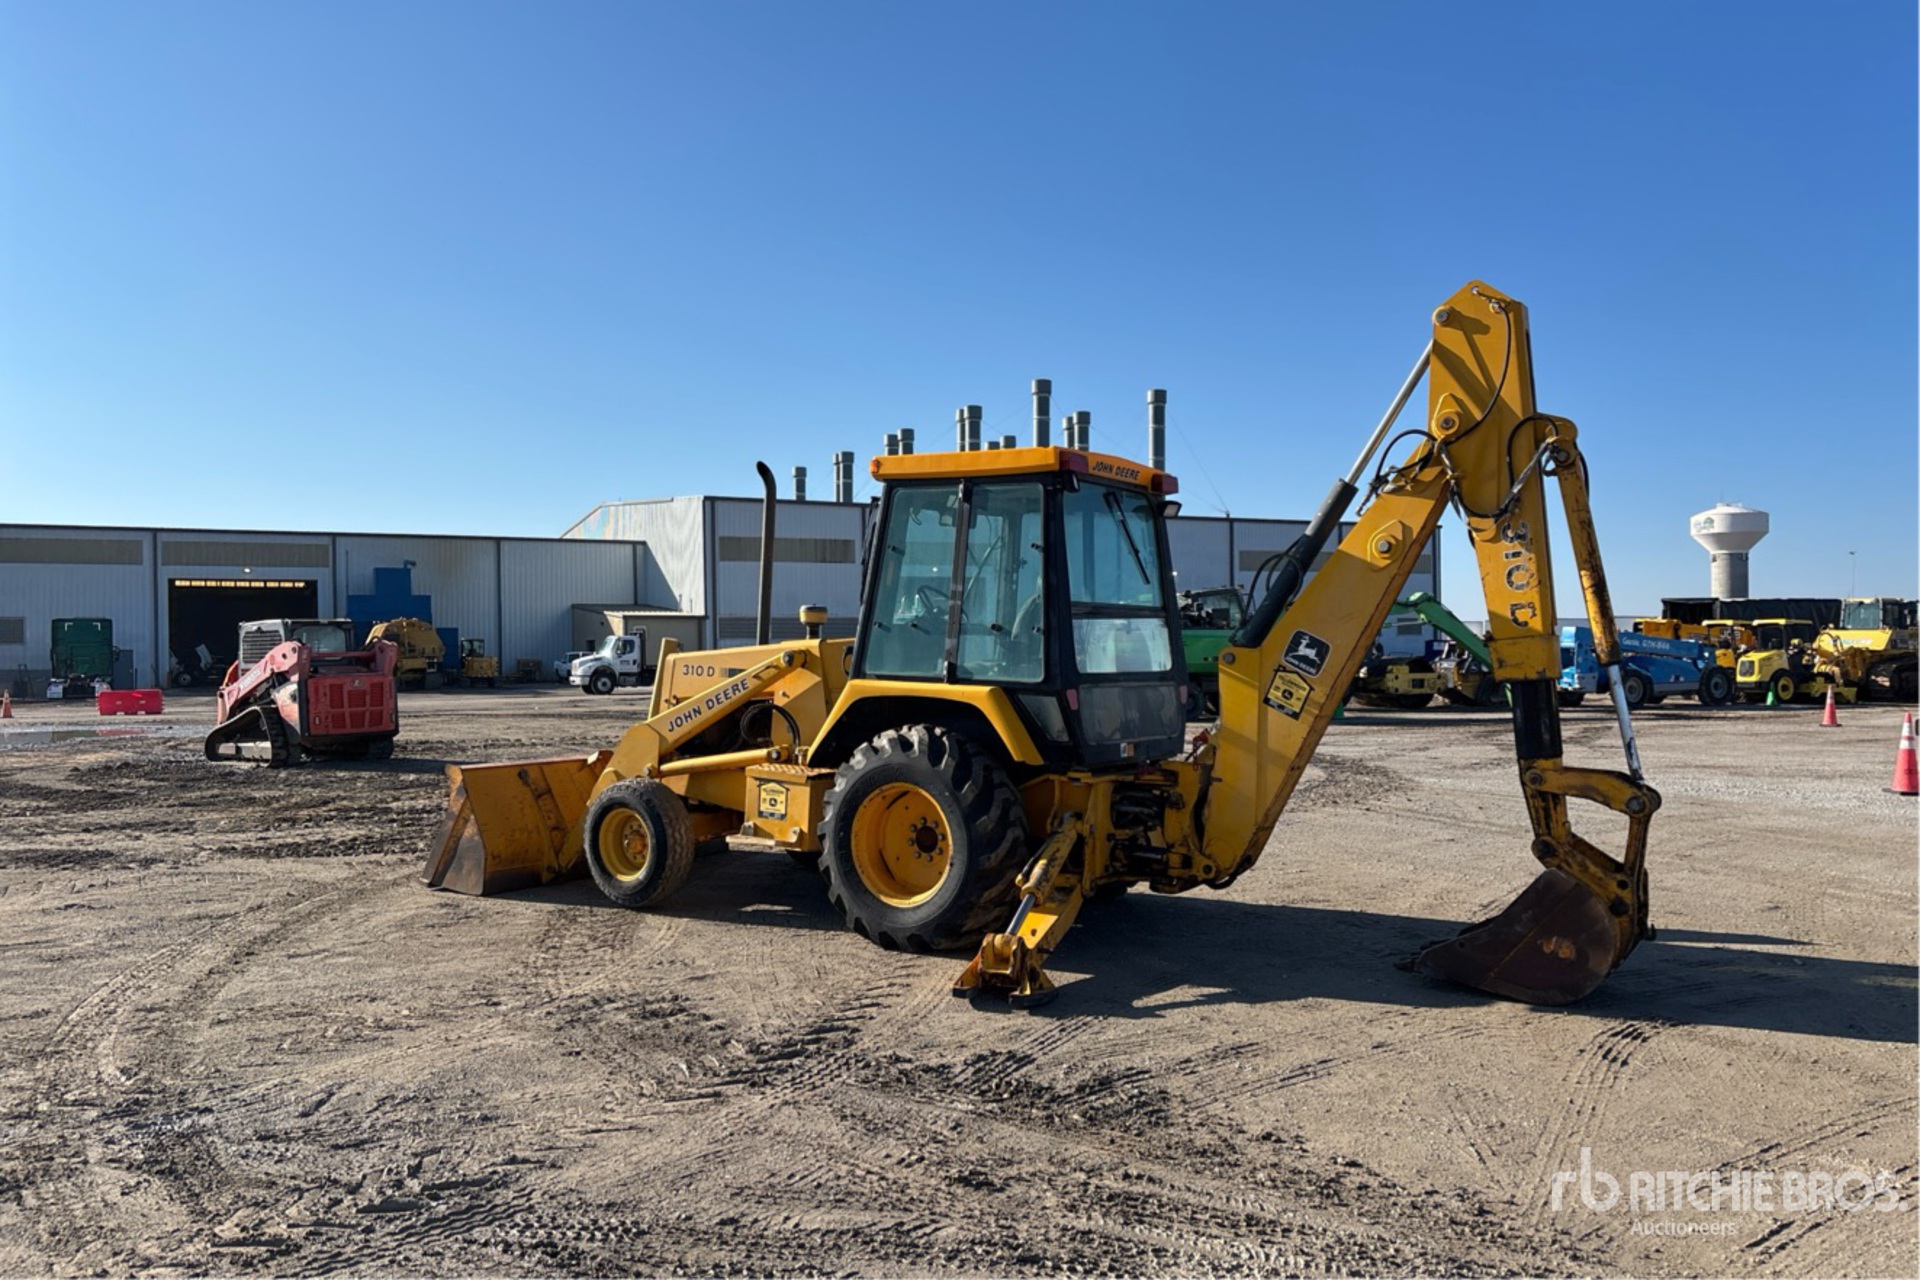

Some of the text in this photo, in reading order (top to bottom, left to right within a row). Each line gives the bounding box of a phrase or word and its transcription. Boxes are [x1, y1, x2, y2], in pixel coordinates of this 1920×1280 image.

[1092, 460, 1140, 480] JOHN DEERE
[683, 664, 715, 677] 310 D
[668, 678, 750, 732] JOHN DEERE
